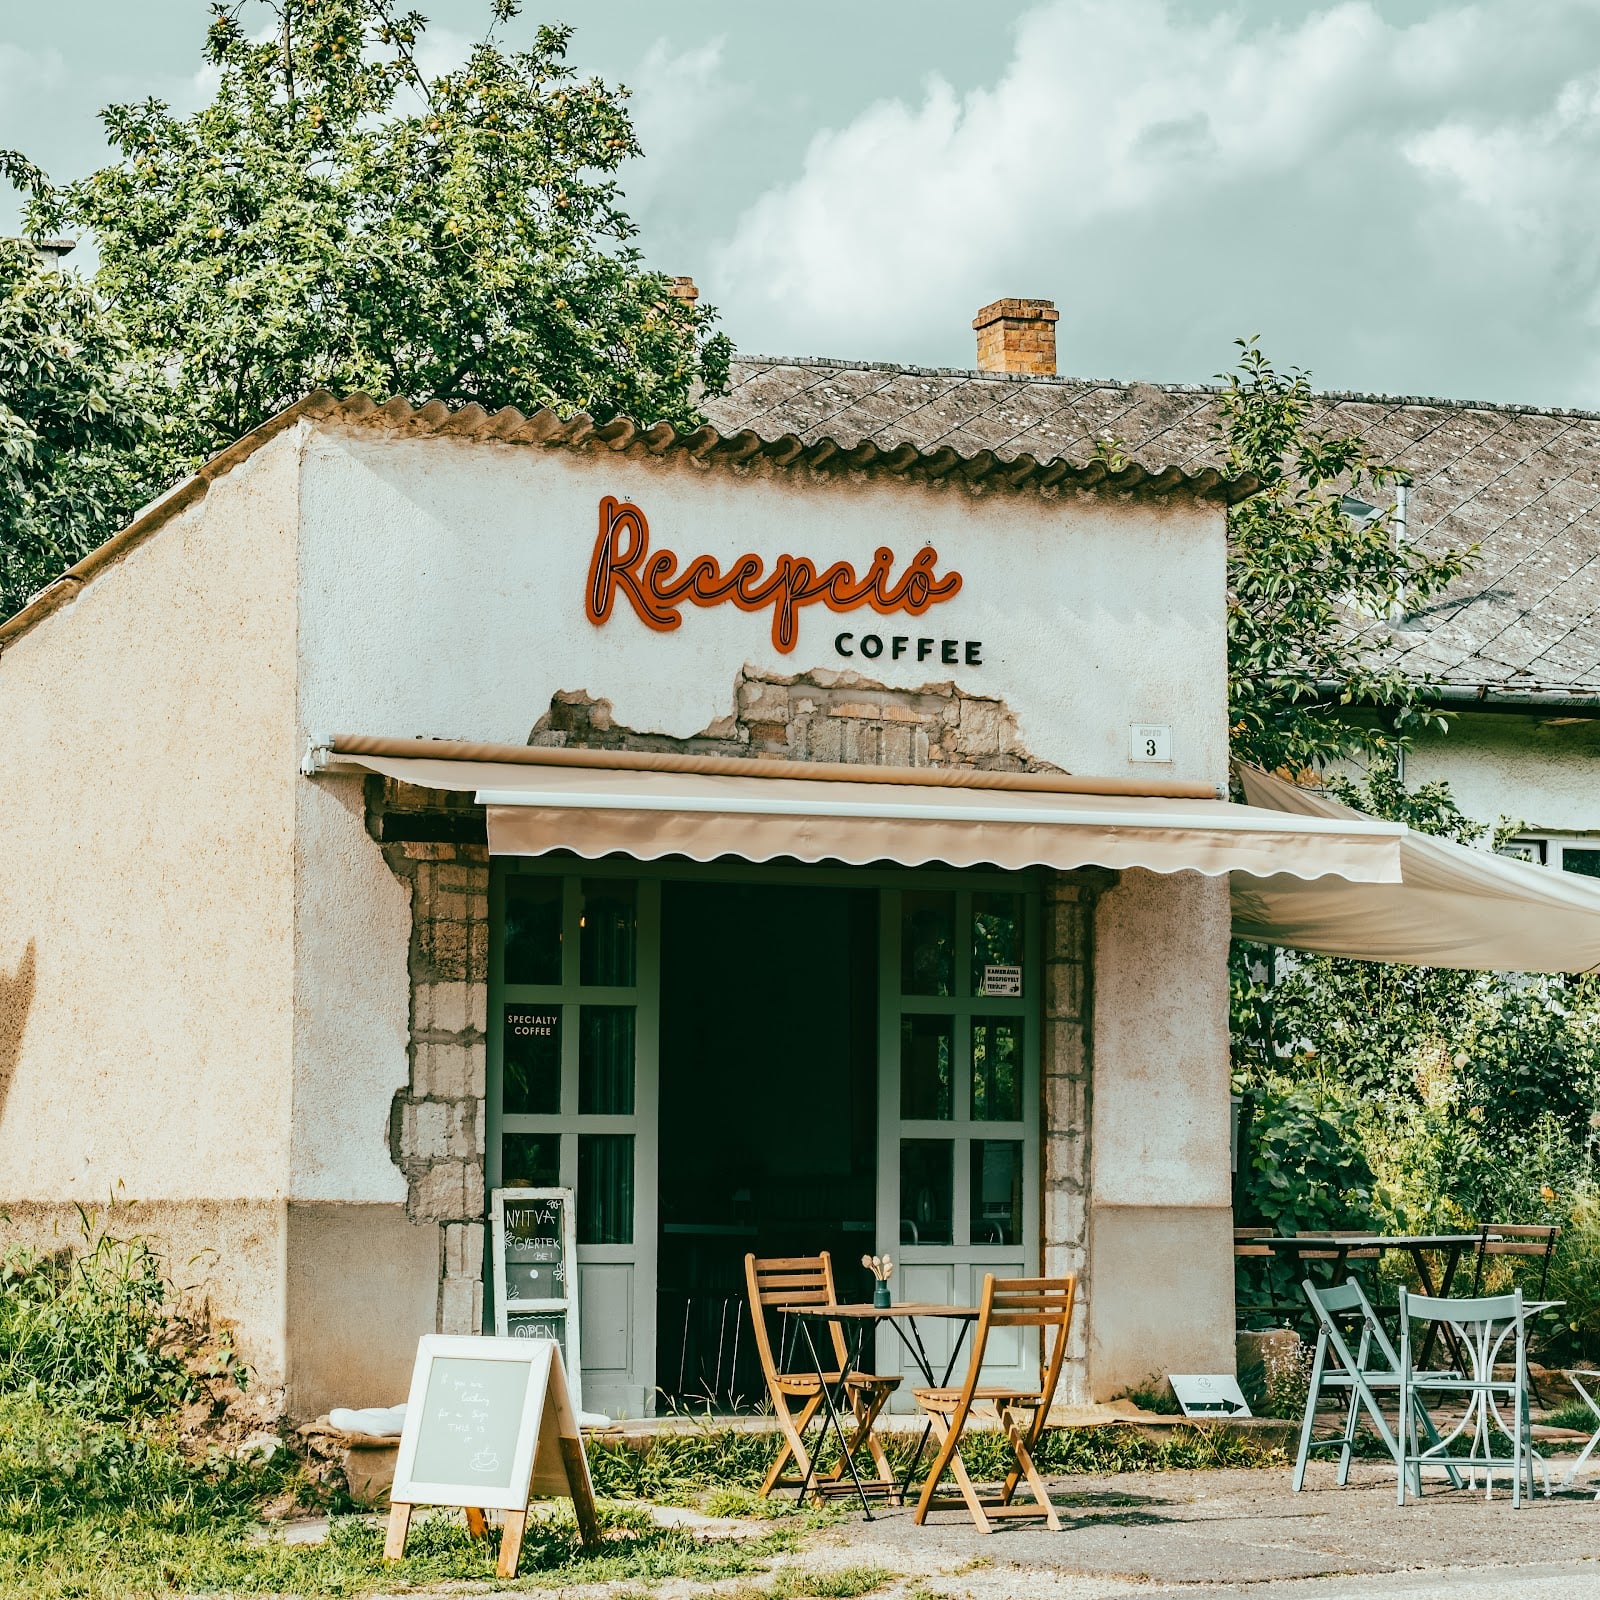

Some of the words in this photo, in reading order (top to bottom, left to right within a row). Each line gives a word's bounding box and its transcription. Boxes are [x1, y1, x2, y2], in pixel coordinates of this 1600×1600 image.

[588, 497, 961, 651] Recepció
[835, 632, 982, 665] COFFEE
[1146, 739, 1156, 757] 3
[508, 1015, 557, 1025] SPECIALTY
[514, 1026, 551, 1036] COFFEE
[506, 1209, 556, 1229] NYITVA
[514, 1237, 561, 1251] GYERTEK
[514, 1323, 556, 1339] OPEN
